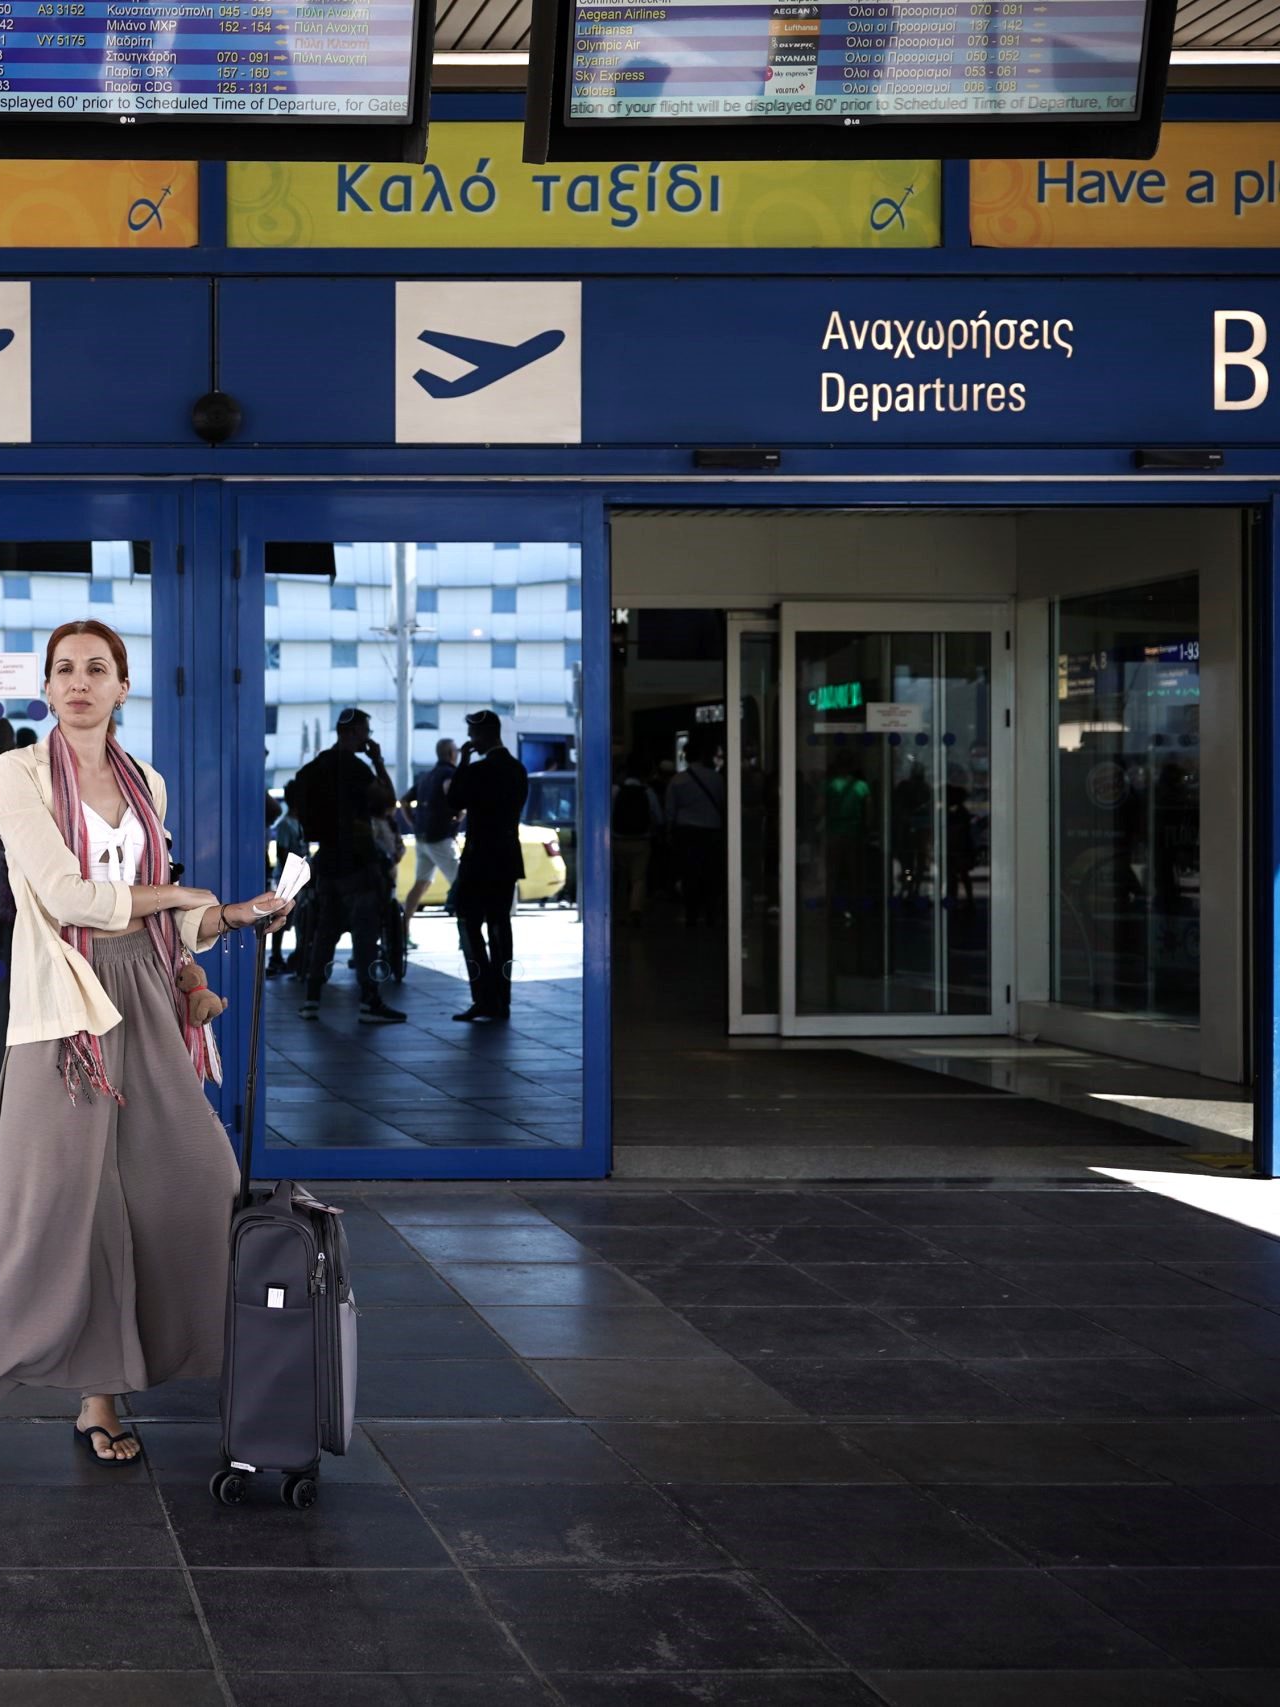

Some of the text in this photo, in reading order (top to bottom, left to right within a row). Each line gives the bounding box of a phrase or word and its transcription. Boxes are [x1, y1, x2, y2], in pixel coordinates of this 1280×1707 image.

[38, 4, 84, 14] A3 3152
[107, 4, 214, 18] Κωνσταντινούπολη
[218, 6, 240, 16] 045
[296, 7, 370, 20] Πύλη Ανοιχτή
[578, 8, 666, 21] Aegean Airlines
[848, 5, 958, 18] Όλοι οι Προορισμοί
[970, 4, 1024, 16] 070 091
[106, 20, 177, 32] Μιλάνο MXP
[219, 22, 272, 32] 152 154
[294, 22, 369, 34] Πύλη Ανοιχτή
[577, 24, 633, 36] Lufthansa
[784, 24, 818, 32] Lufthansa
[847, 21, 956, 34] Όλοι οι Προορισμοί
[1003, 20, 1023, 30] 142
[36, 34, 86, 46] VY 5175
[106, 35, 153, 48] Μαδρίτη
[576, 40, 640, 52] Olympic Air
[846, 36, 955, 50] Όλοι οι Προορισμοί
[967, 35, 1020, 46] 070 091
[105, 50, 177, 64] Στουτγκάρδη
[216, 52, 270, 63] 070 091
[292, 52, 368, 65] Πύλη Ανοιχτή
[576, 56, 619, 68] Ryanair
[775, 54, 816, 62] RYANAIR
[845, 52, 954, 64] Όλοι οι Προορισμοί
[105, 66, 173, 78] Παρίσι ORY
[216, 68, 270, 79] 157 160
[575, 70, 645, 83] Sky Express
[774, 70, 784, 78] sky
[844, 66, 952, 80] Όλοι οι Προορισμοί
[996, 66, 1018, 76] 061
[104, 81, 173, 94] Παρίσι CDG
[216, 82, 268, 94] 125 131
[575, 86, 616, 96] Volotea
[842, 82, 950, 94] Όλοι οι Προορισμοί
[58, 96, 78, 108] 60'
[82, 96, 113, 112] prior
[118, 97, 130, 109] to
[135, 96, 208, 110] Scheduled
[212, 97, 246, 110] Time
[250, 98, 264, 110] of
[268, 98, 340, 113] Departure,
[345, 98, 364, 111] for
[368, 98, 408, 112] Gates
[608, 101, 623, 114] of
[625, 103, 656, 116] your
[660, 100, 694, 115] flight
[696, 100, 720, 112] will
[724, 100, 741, 112] be
[744, 100, 812, 114] displayed
[815, 98, 837, 111] 60'
[840, 98, 873, 114] prior
[876, 99, 890, 110] to
[894, 98, 968, 110] Scheduled
[972, 97, 1006, 110] Time
[1010, 96, 1024, 109] of
[1028, 96, 1102, 112] Departure,
[1106, 95, 1126, 108] for
[336, 157, 720, 228] Καλό ταξίδι
[1036, 159, 1280, 217] Have a pl
[821, 310, 1074, 359] Αναχωρήσεις
[1213, 310, 1269, 411] B
[821, 372, 1026, 422] Departures
